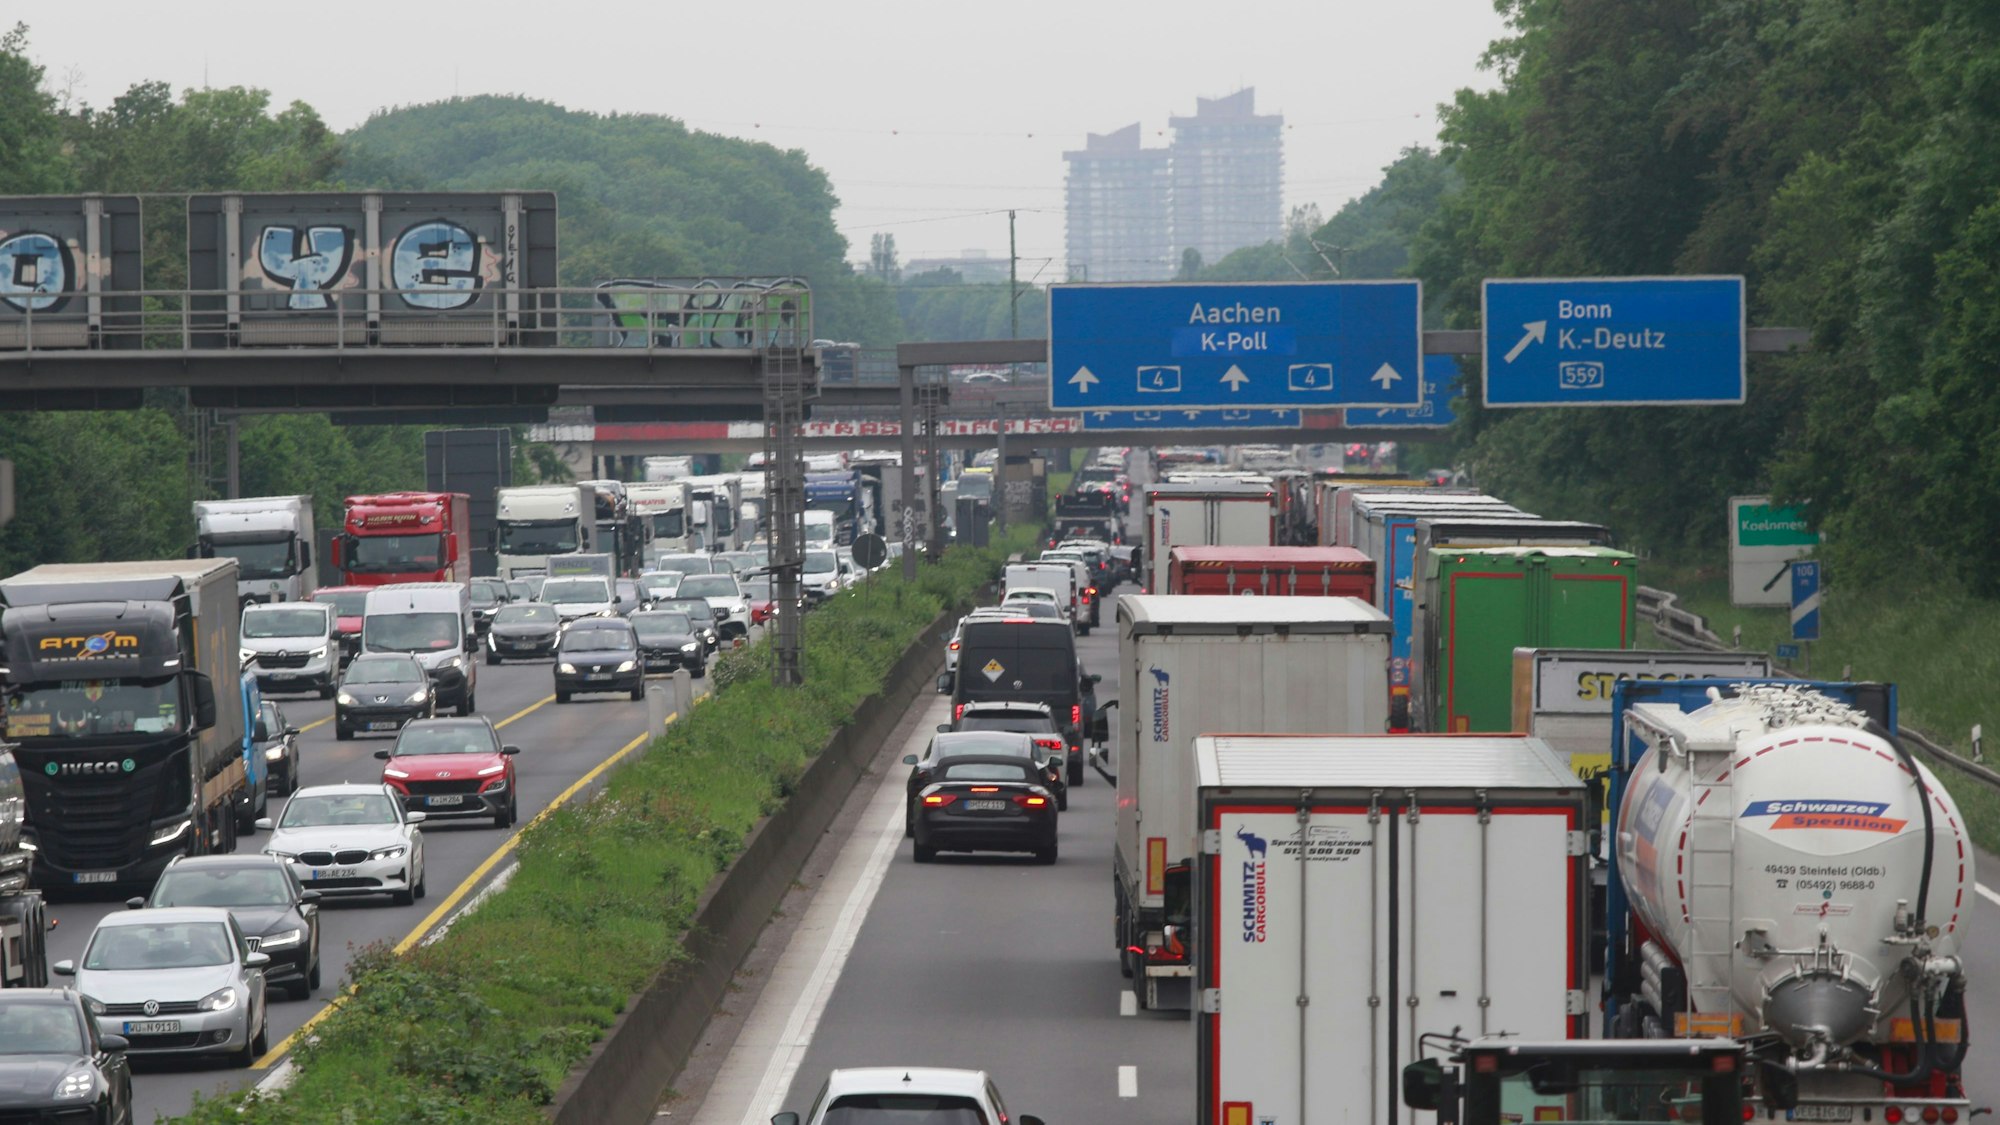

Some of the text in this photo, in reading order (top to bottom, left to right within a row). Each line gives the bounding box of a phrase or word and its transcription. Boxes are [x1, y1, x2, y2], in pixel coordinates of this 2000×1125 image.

[1188, 302, 1281, 324] Aachen
[1559, 300, 1612, 319] Bonn
[1201, 331, 1268, 351] K-Poll
[1559, 327, 1666, 349] K.-Deutz
[1153, 371, 1164, 387] 4
[1305, 369, 1316, 385] 4
[1565, 367, 1598, 383] 559
[1153, 687, 1162, 742] SCHMITZ
[61, 761, 119, 776] IVECO
[1766, 801, 1879, 815] Schwarzer
[1793, 816, 1893, 830] Spedition
[1765, 864, 1796, 874] 49439
[1800, 866, 1848, 876] Steinfeld
[1796, 880, 1875, 891] (05492) 9688-0
[1243, 861, 1255, 943] SCHMITZ
[1256, 861, 1266, 943] CARGOBULL
[155, 1022, 178, 1032] 9118
